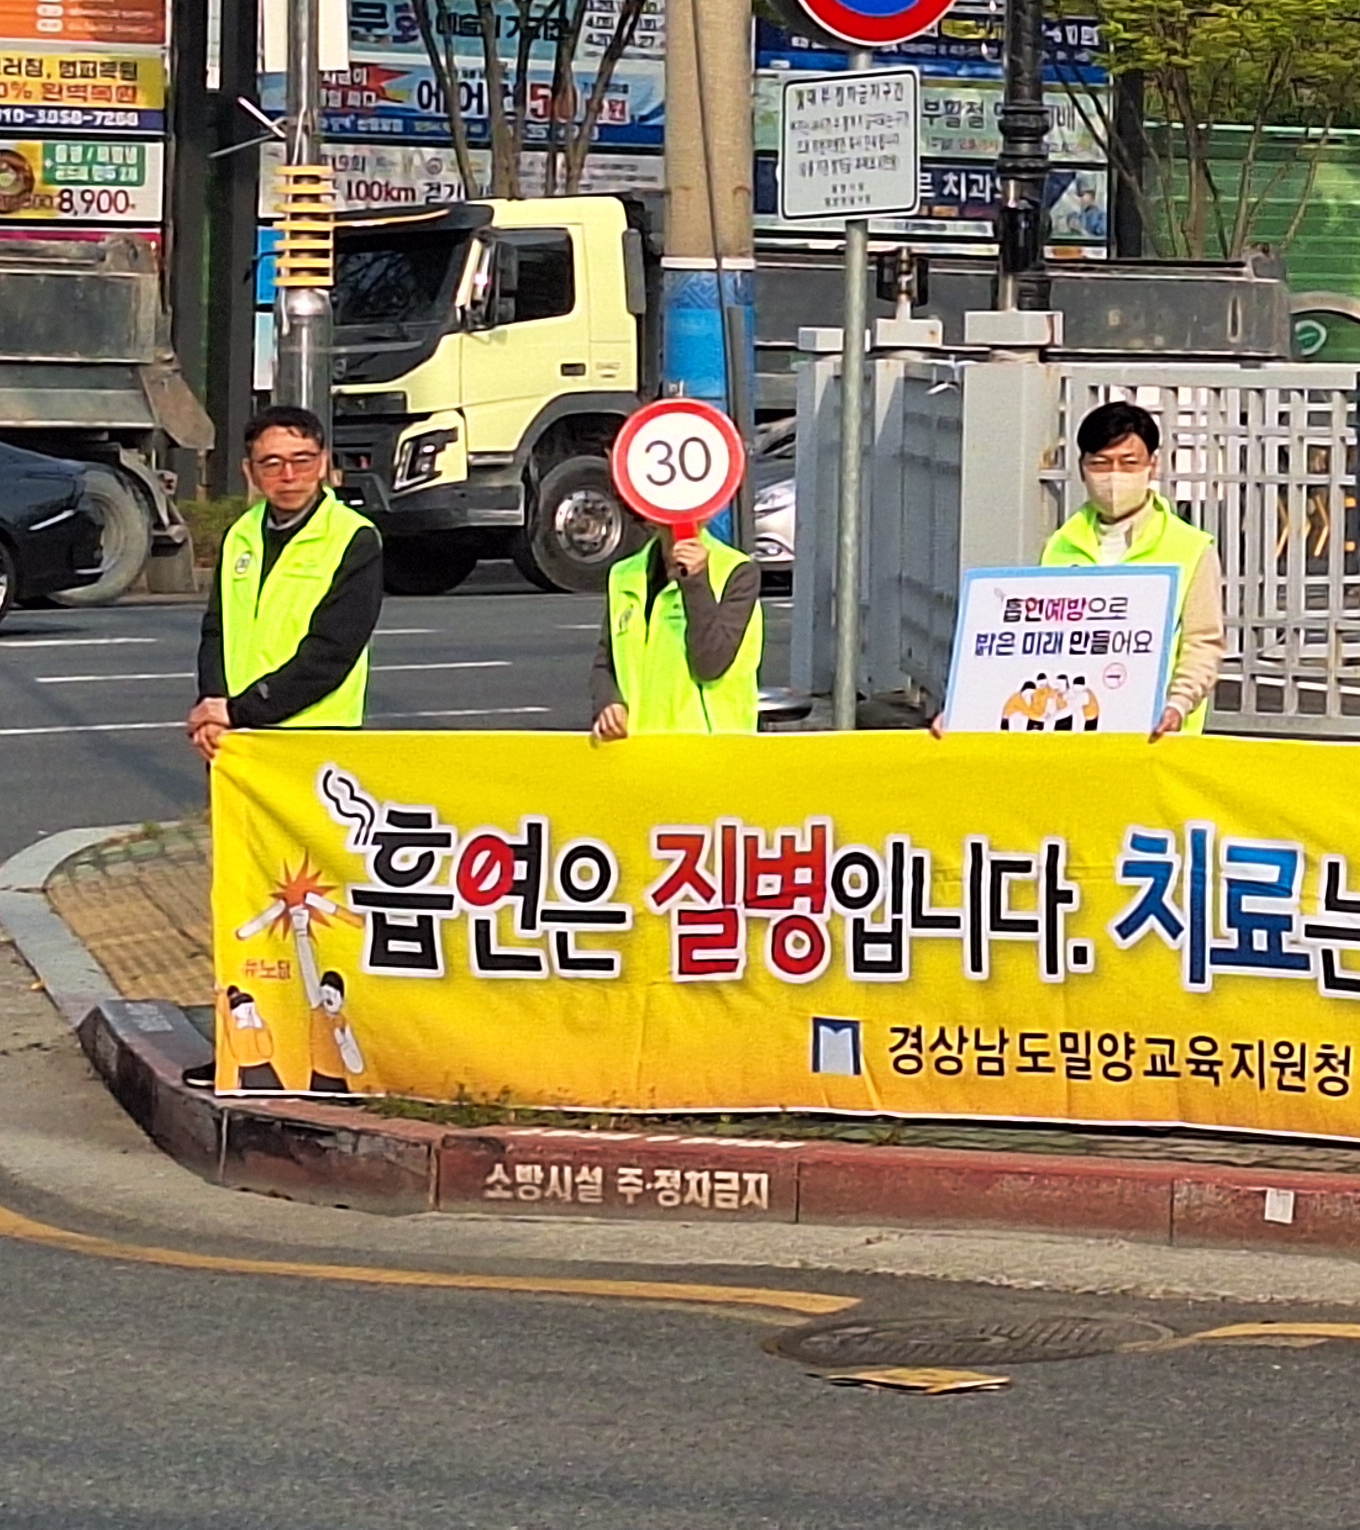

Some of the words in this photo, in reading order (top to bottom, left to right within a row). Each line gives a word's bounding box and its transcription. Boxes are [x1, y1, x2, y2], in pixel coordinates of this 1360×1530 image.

[645, 436, 712, 487] 30
[974, 632, 1016, 657] 밝은
[1021, 631, 1064, 656] 미래
[1068, 630, 1154, 656] 만들어요
[351, 810, 628, 973] 흡연은
[651, 822, 1090, 978] 질병입니다.
[887, 1024, 1352, 1098] 경상남도밀양교육지원청
[483, 1163, 604, 1204] 소방시설
